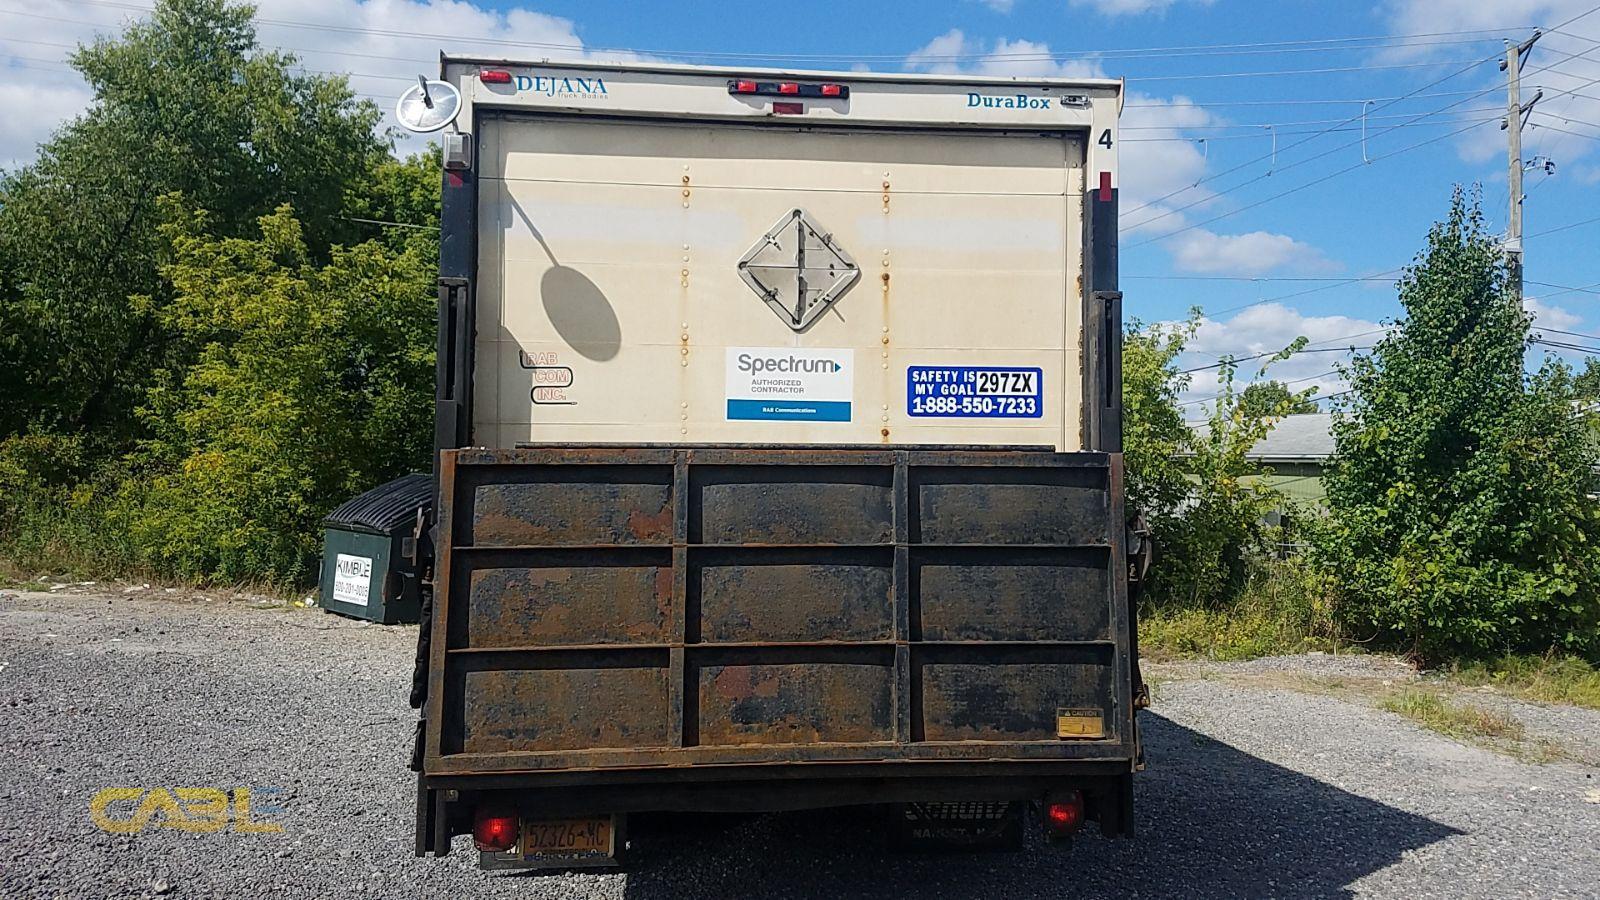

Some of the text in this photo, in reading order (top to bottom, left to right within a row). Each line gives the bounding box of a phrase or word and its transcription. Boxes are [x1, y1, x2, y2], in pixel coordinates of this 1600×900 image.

[516, 76, 608, 97] DEJANA
[967, 92, 1051, 110] DuraBox
[1098, 128, 1113, 150] 4
[527, 351, 558, 366] RAB
[737, 353, 835, 376] Spectrum
[534, 370, 569, 383] COM
[751, 379, 802, 387] AUTHORIZED
[912, 370, 976, 383] SAFETY IS
[978, 372, 1033, 393] 297ZX
[537, 388, 567, 401] INC.
[751, 386, 805, 394] CONTRACTOR
[915, 383, 975, 396] MY GOAL
[912, 396, 1037, 415] 1-888-550-7233
[338, 559, 370, 578] KIMBLE
